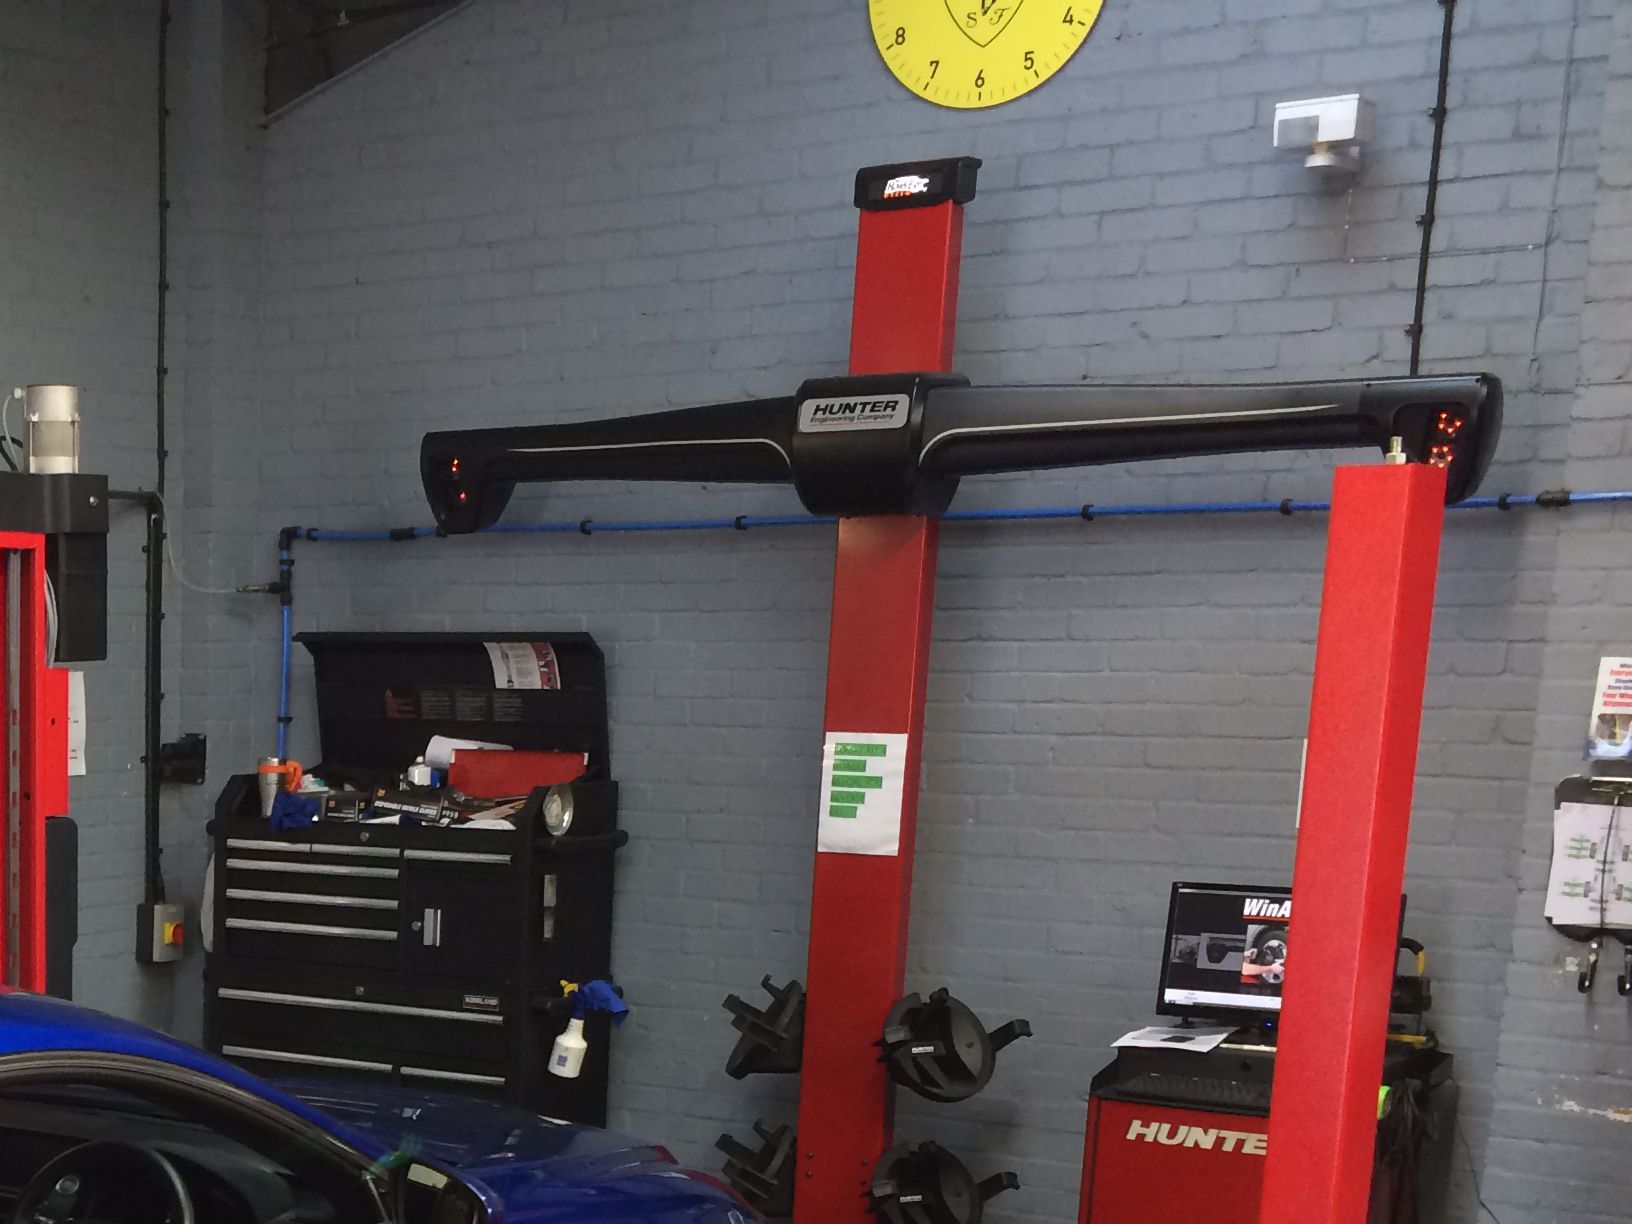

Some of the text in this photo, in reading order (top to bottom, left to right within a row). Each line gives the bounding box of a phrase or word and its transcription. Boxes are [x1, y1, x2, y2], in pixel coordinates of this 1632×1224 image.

[966, 12, 977, 28] S
[1062, 6, 1074, 25] 4
[895, 27, 906, 45] 8
[929, 60, 939, 79] 7
[1023, 51, 1035, 71] 5
[975, 69, 985, 88] 6
[813, 400, 899, 416] HUNTER
[1243, 897, 1292, 918] WinA
[1126, 1119, 1268, 1155] HUNTE
